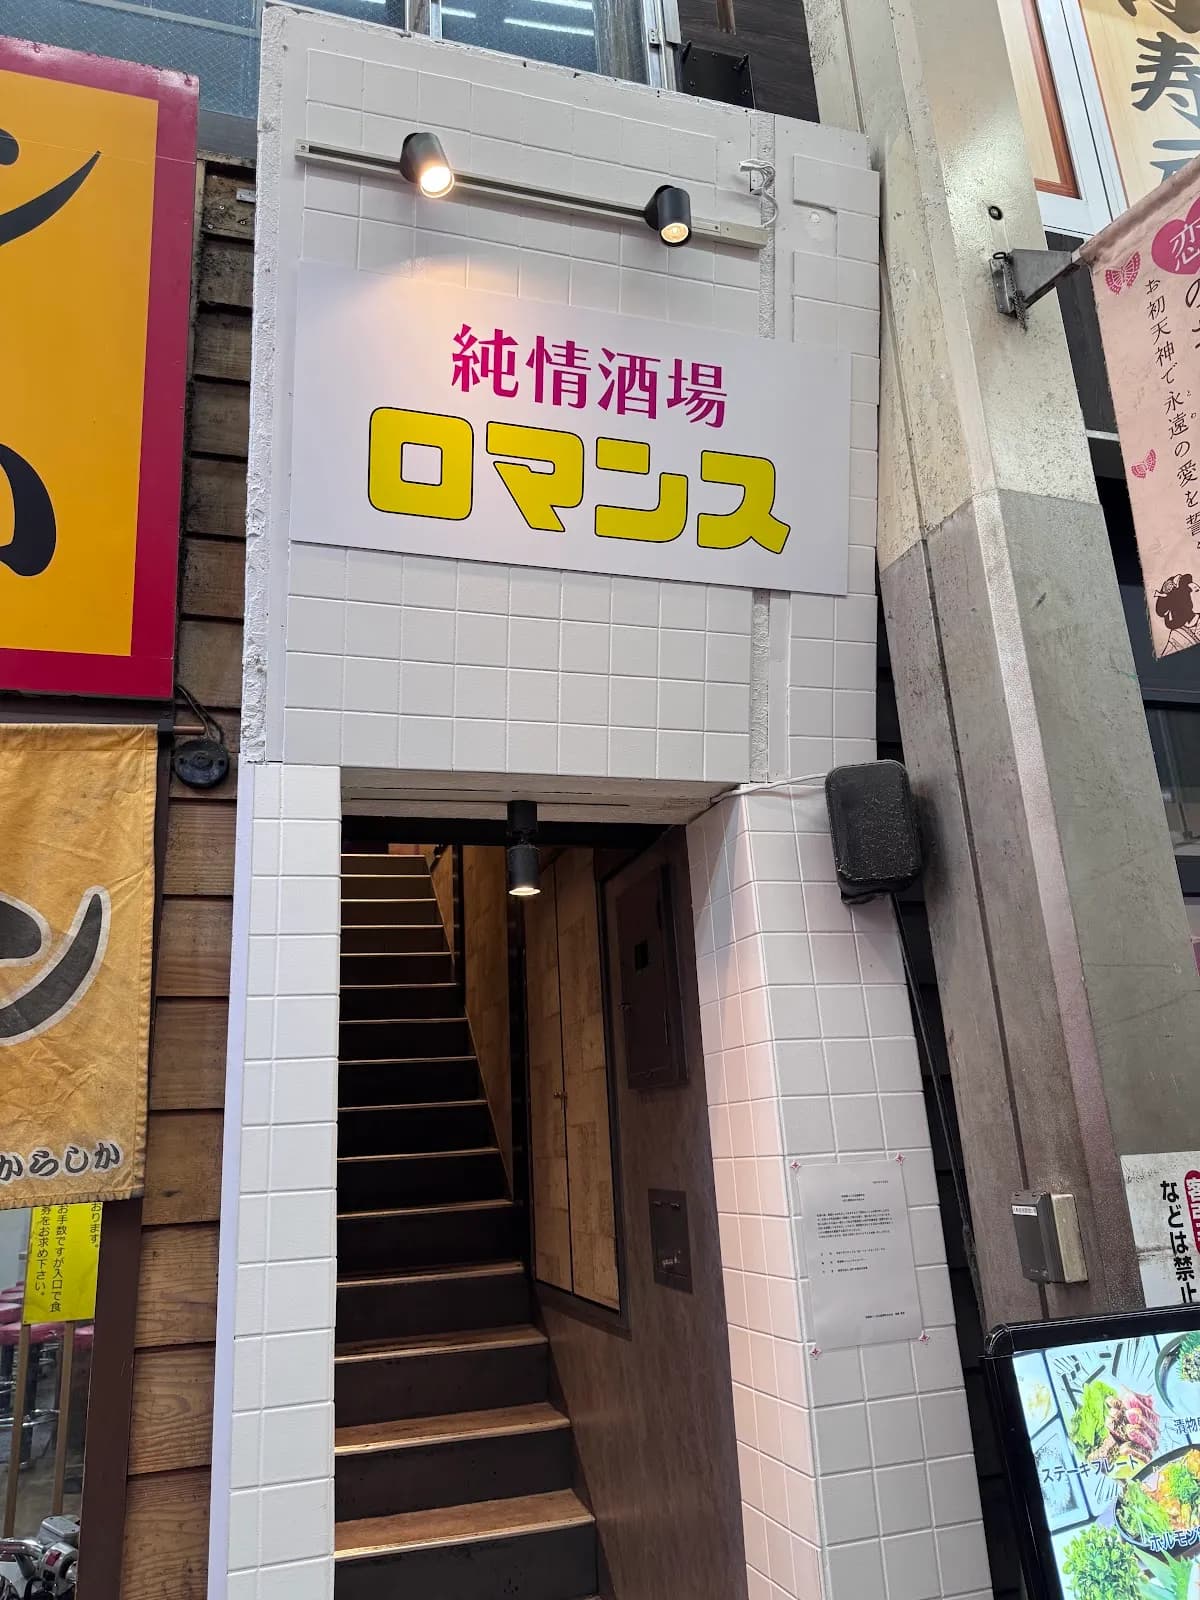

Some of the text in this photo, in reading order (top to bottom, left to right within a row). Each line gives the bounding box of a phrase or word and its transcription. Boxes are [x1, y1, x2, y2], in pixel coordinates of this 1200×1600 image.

[452, 323, 727, 428] 純情酒場
[1145, 279, 1200, 549] お初天神で永遠の愛を誓
[368, 406, 791, 555] ロマンス
[1149, 1526, 1200, 1553] ホルモン
